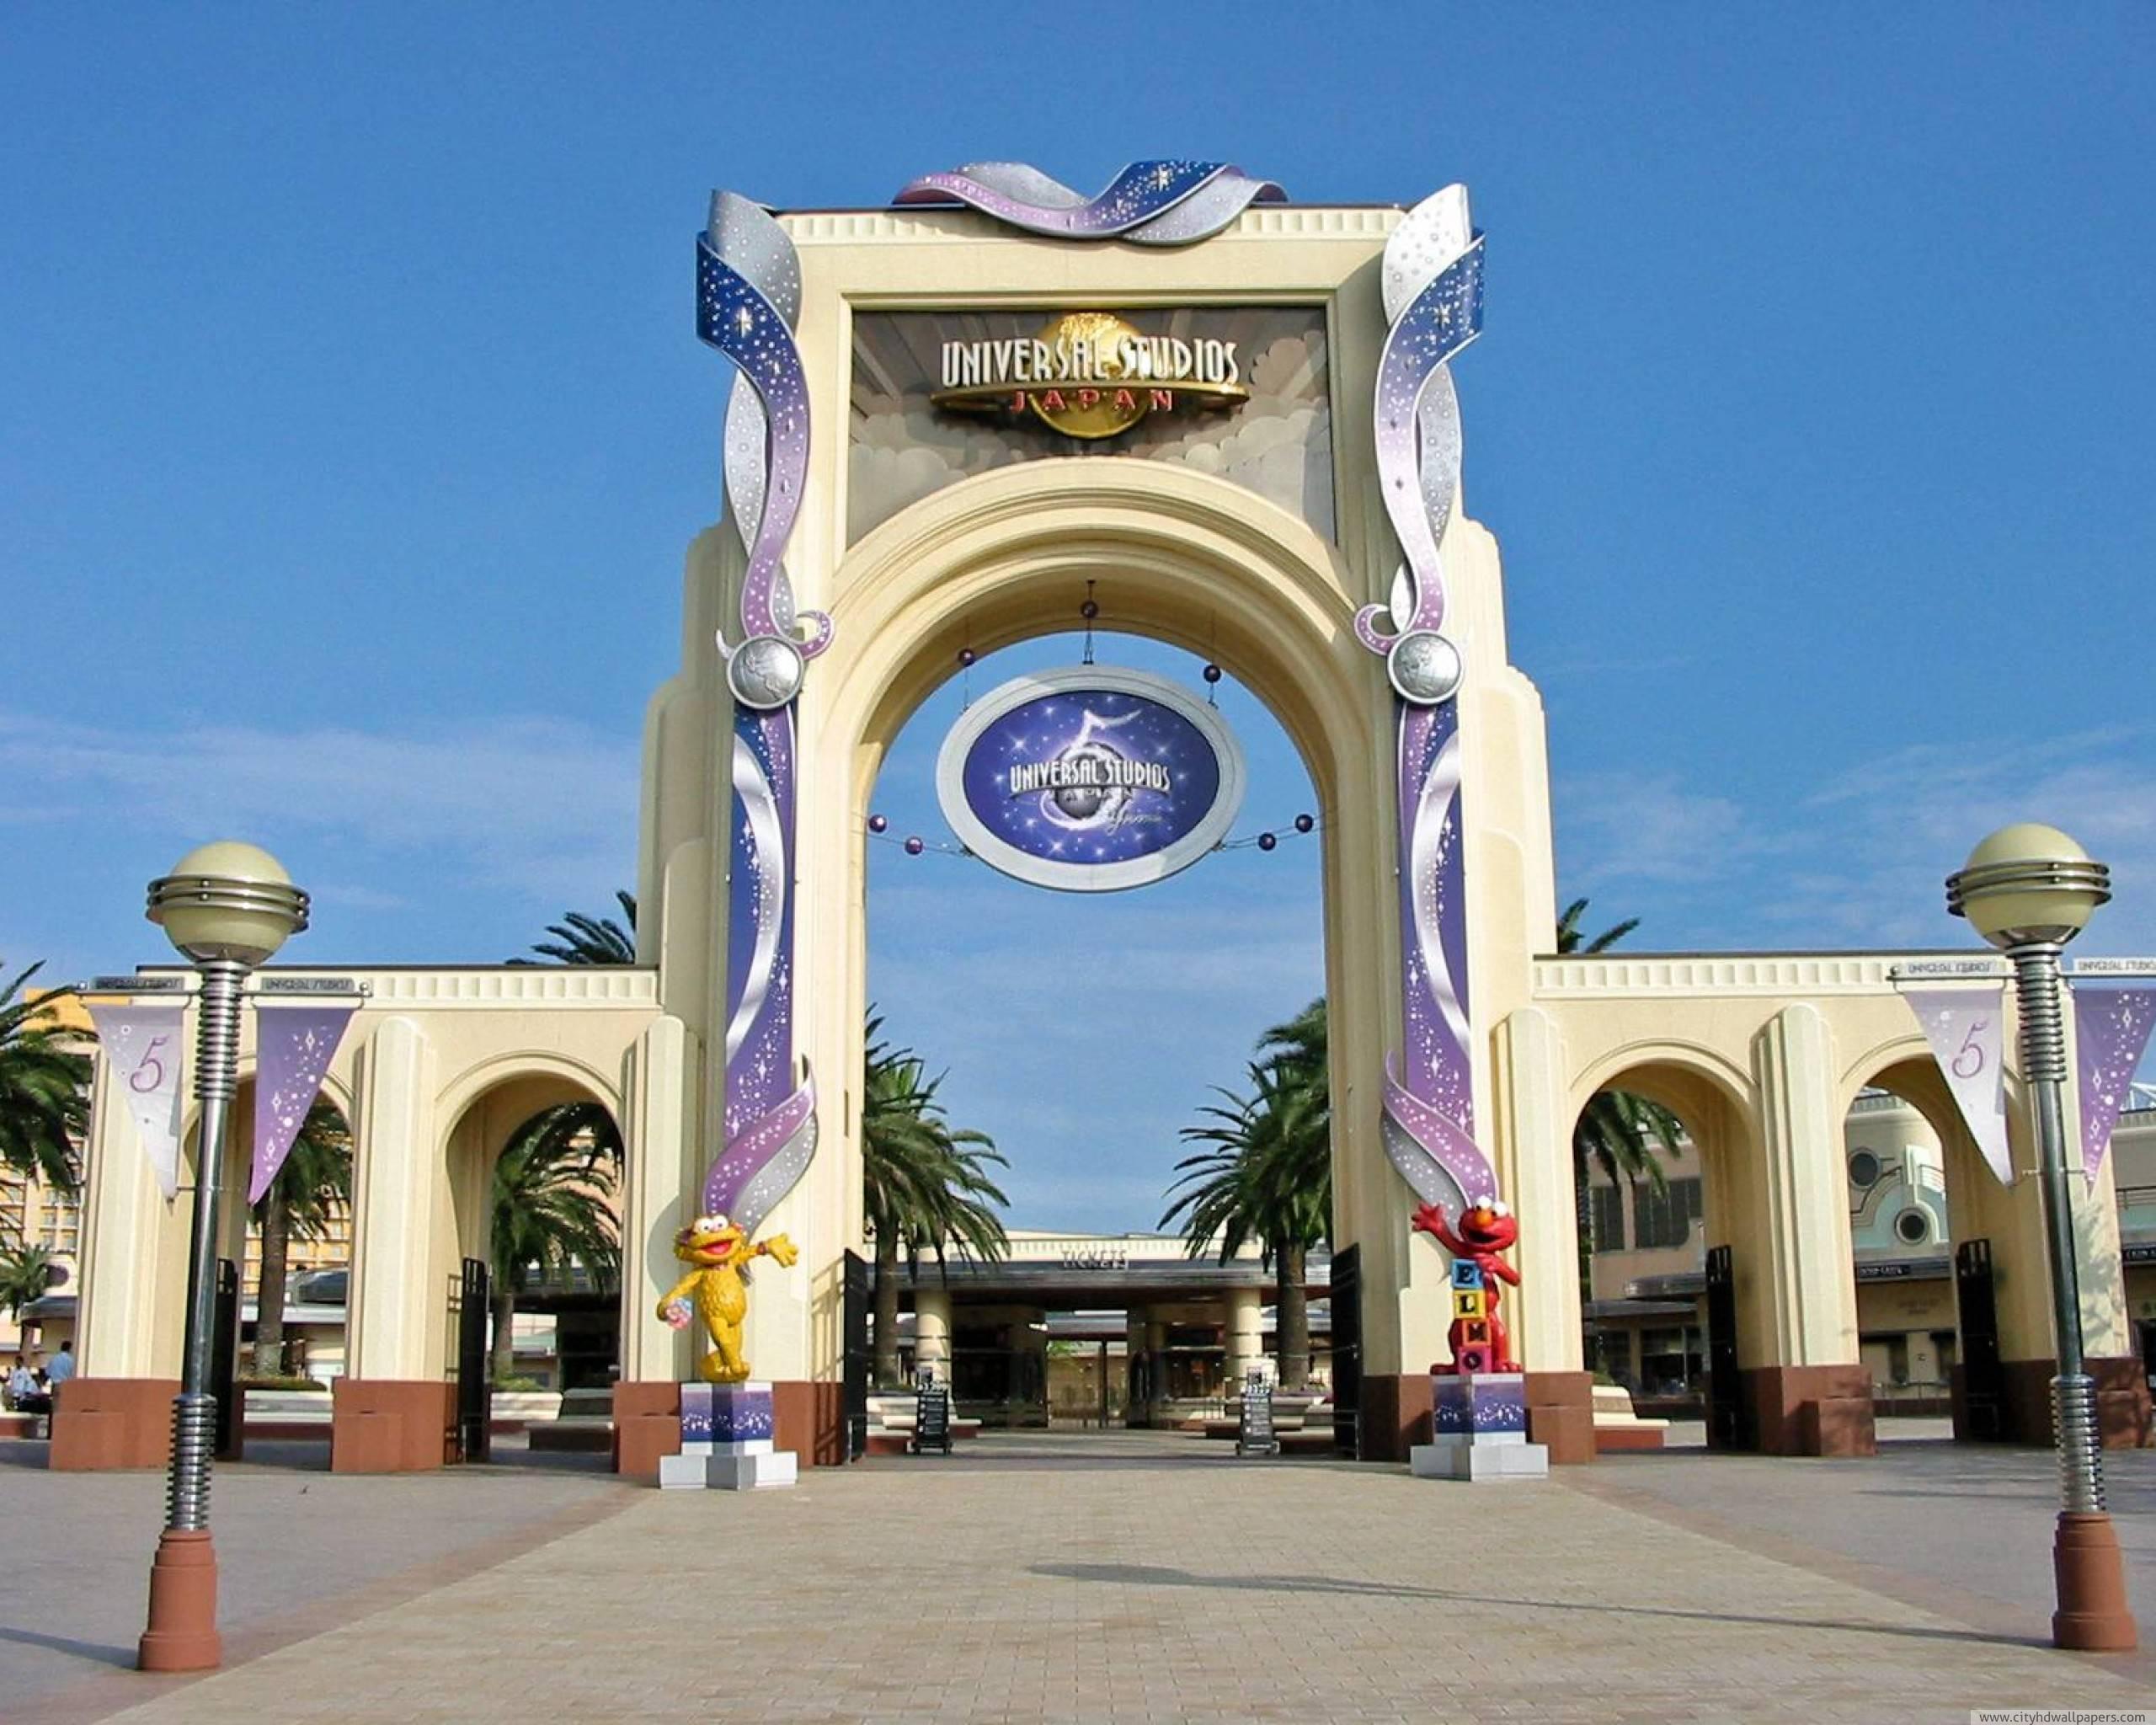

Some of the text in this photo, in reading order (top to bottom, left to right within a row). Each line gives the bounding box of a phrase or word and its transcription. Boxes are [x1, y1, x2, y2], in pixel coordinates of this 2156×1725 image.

[942, 337, 1239, 387] UNIVERSAL STUDIOS
[1010, 389, 1173, 412] JAPAN
[1011, 759, 1170, 793] UNIVERSAL STUDIOS
[130, 1036, 168, 1093] 5
[1951, 1019, 1988, 1079] 5
[1061, 1250, 1129, 1270] TICKETS
